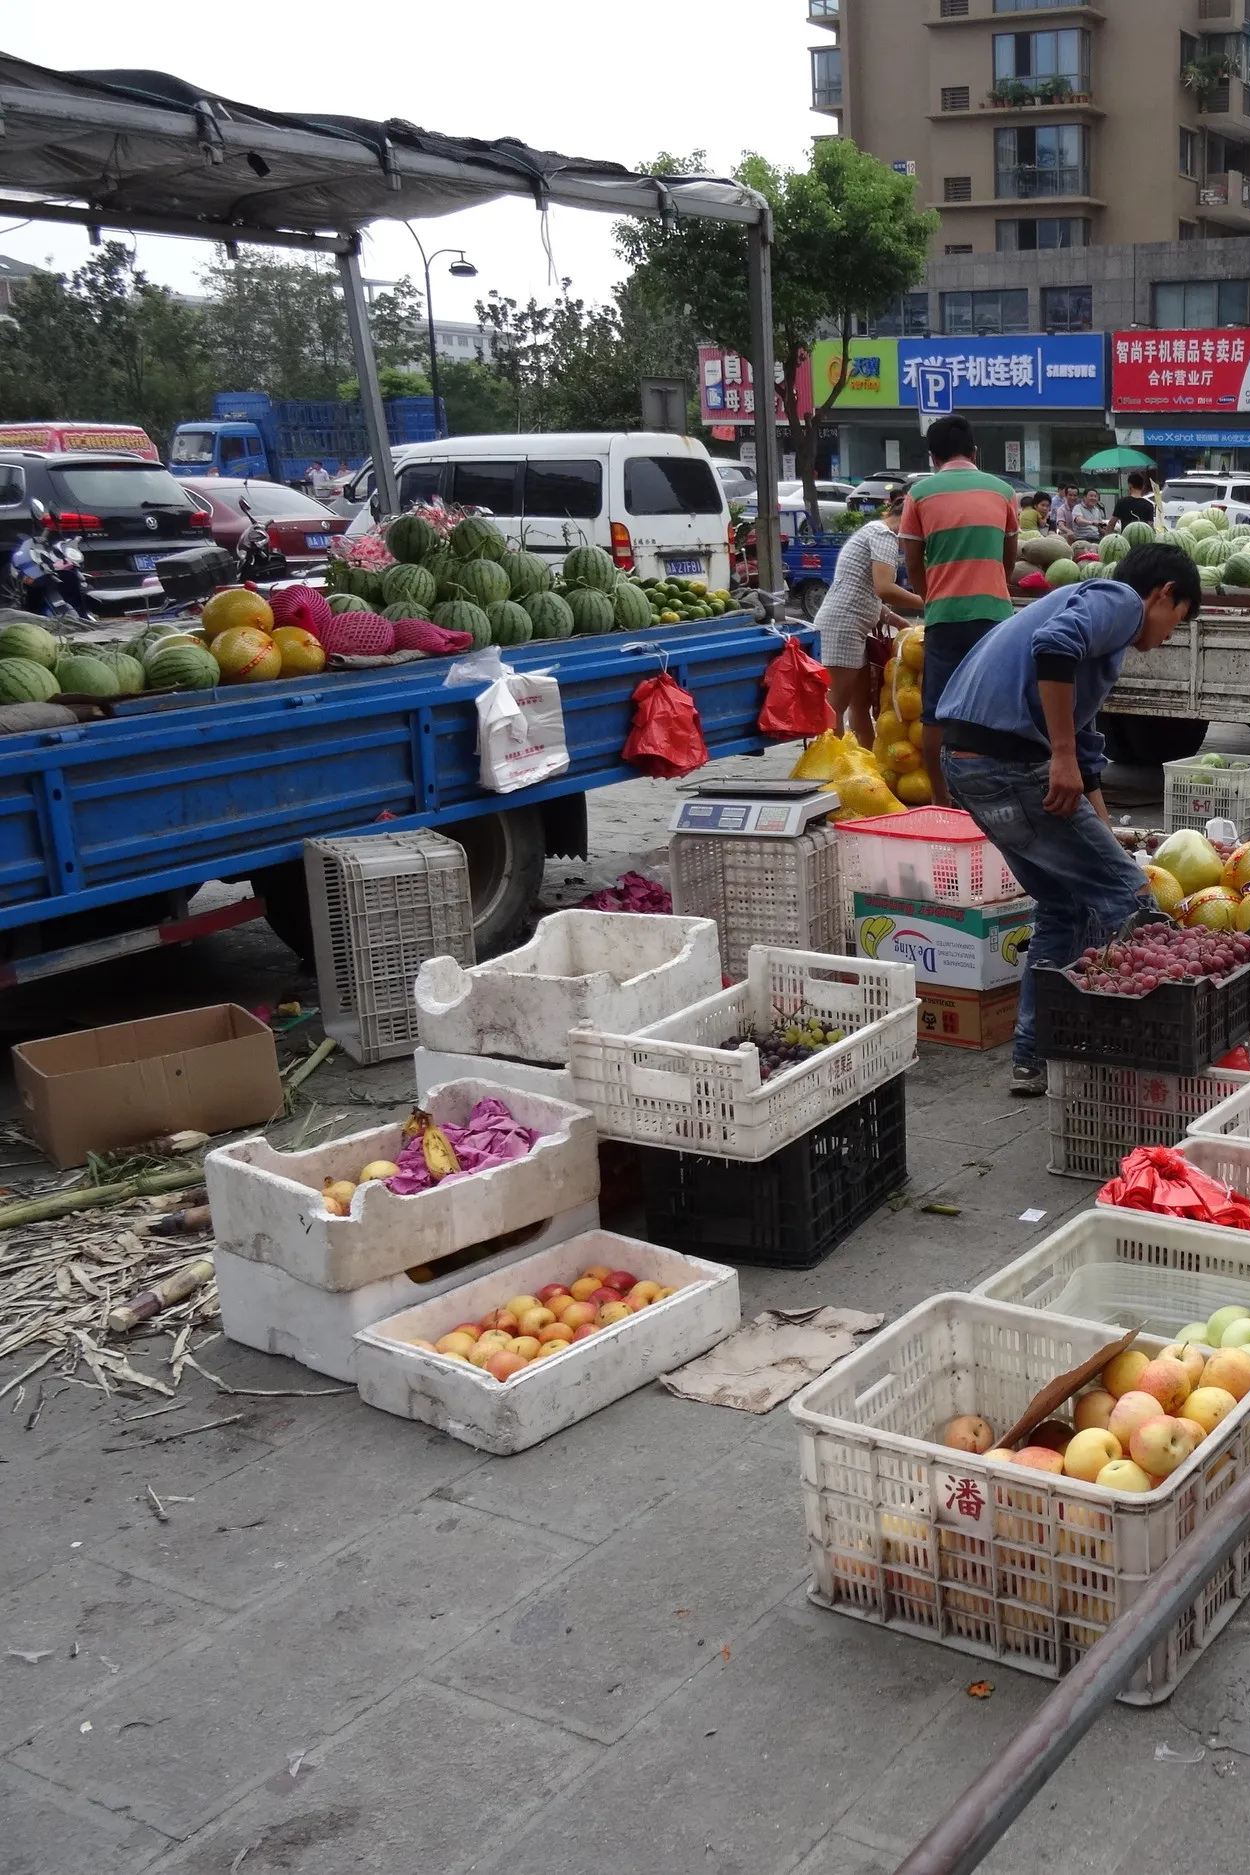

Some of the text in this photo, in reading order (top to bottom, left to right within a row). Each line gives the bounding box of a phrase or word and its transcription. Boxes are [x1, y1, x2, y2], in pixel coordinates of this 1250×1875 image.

[1116, 338, 1245, 363] 智尚手机精品专卖店
[1046, 364, 1097, 378] SAMSUNG
[1148, 369, 1214, 387] 合作营业厅
[925, 373, 945, 407] P
[917, 905, 965, 923] Super
[944, 1474, 986, 1521] 潘
